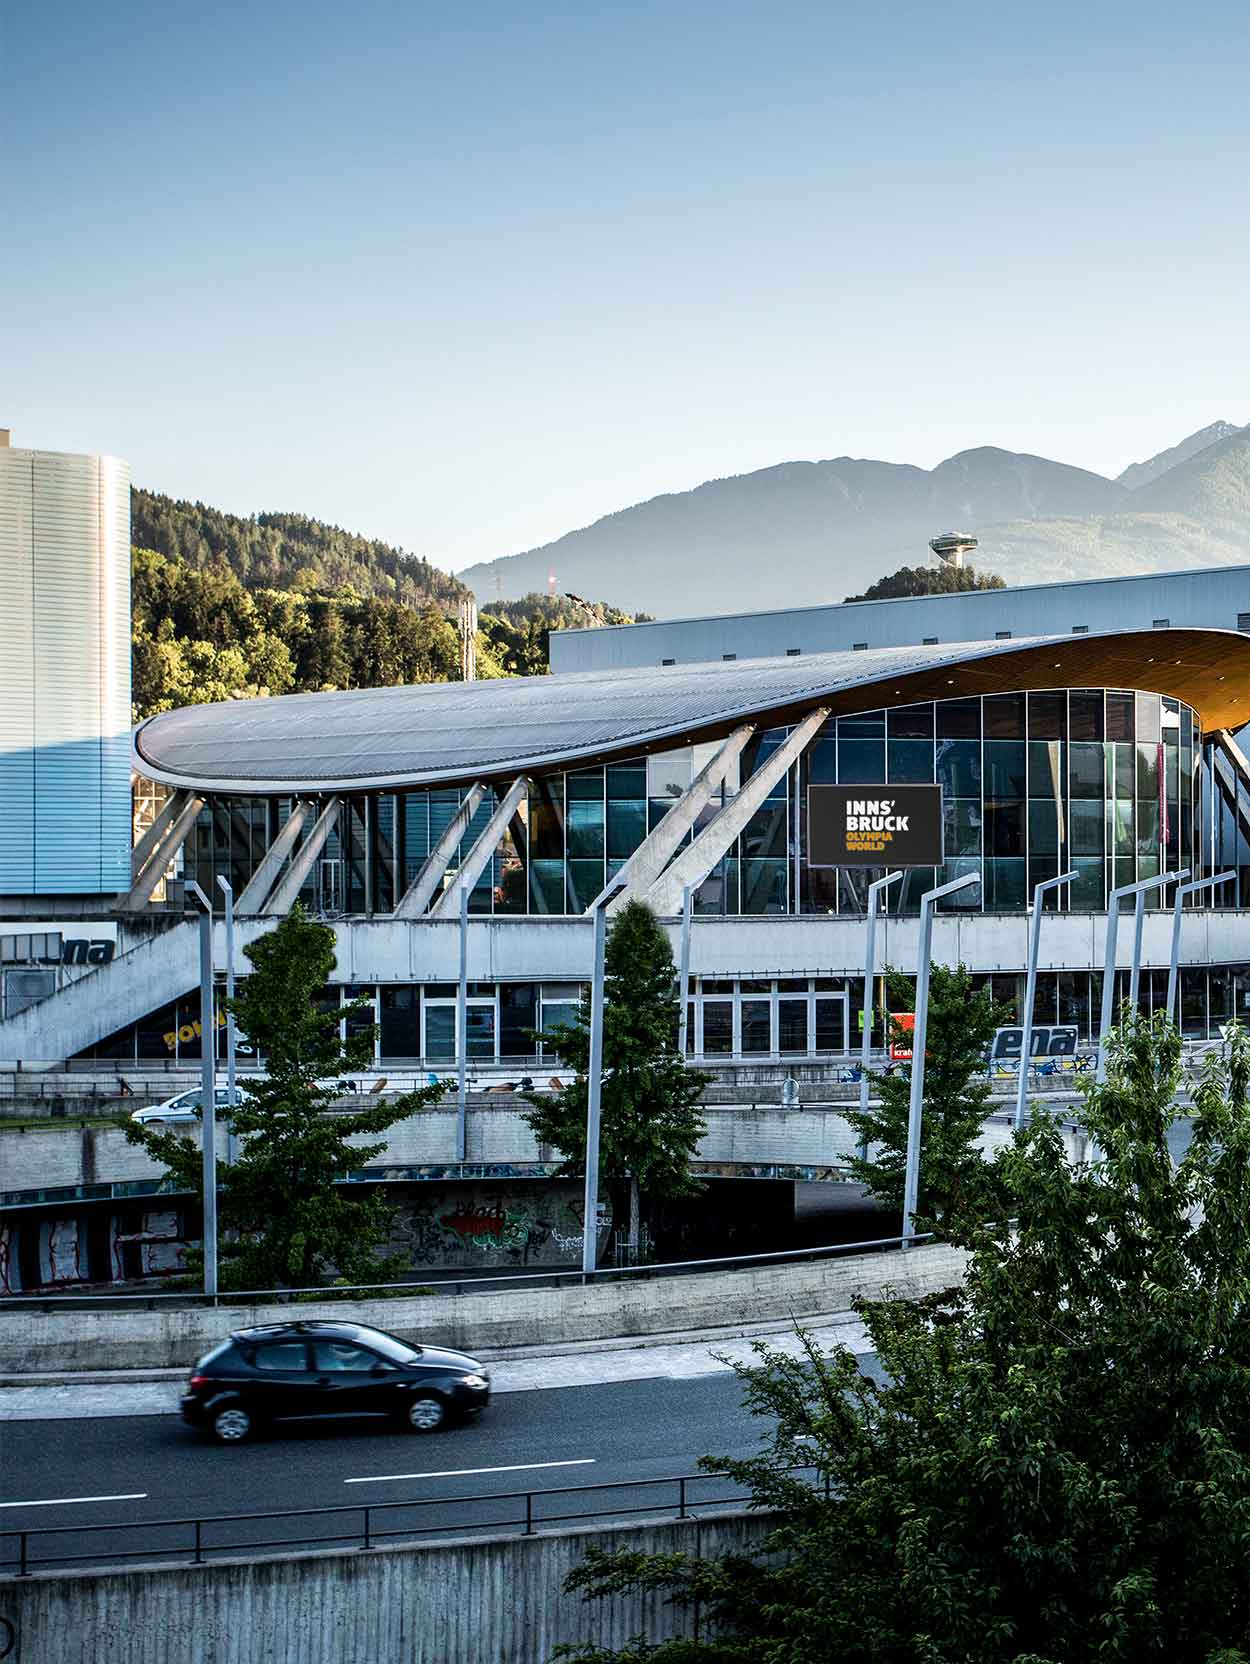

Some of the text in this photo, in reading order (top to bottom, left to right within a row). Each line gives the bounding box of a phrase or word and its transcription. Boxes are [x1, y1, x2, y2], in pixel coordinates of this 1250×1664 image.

[845, 816, 910, 831] BRUCK
[845, 832, 893, 841] OLYMPIA
[845, 841, 886, 851] WORLD
